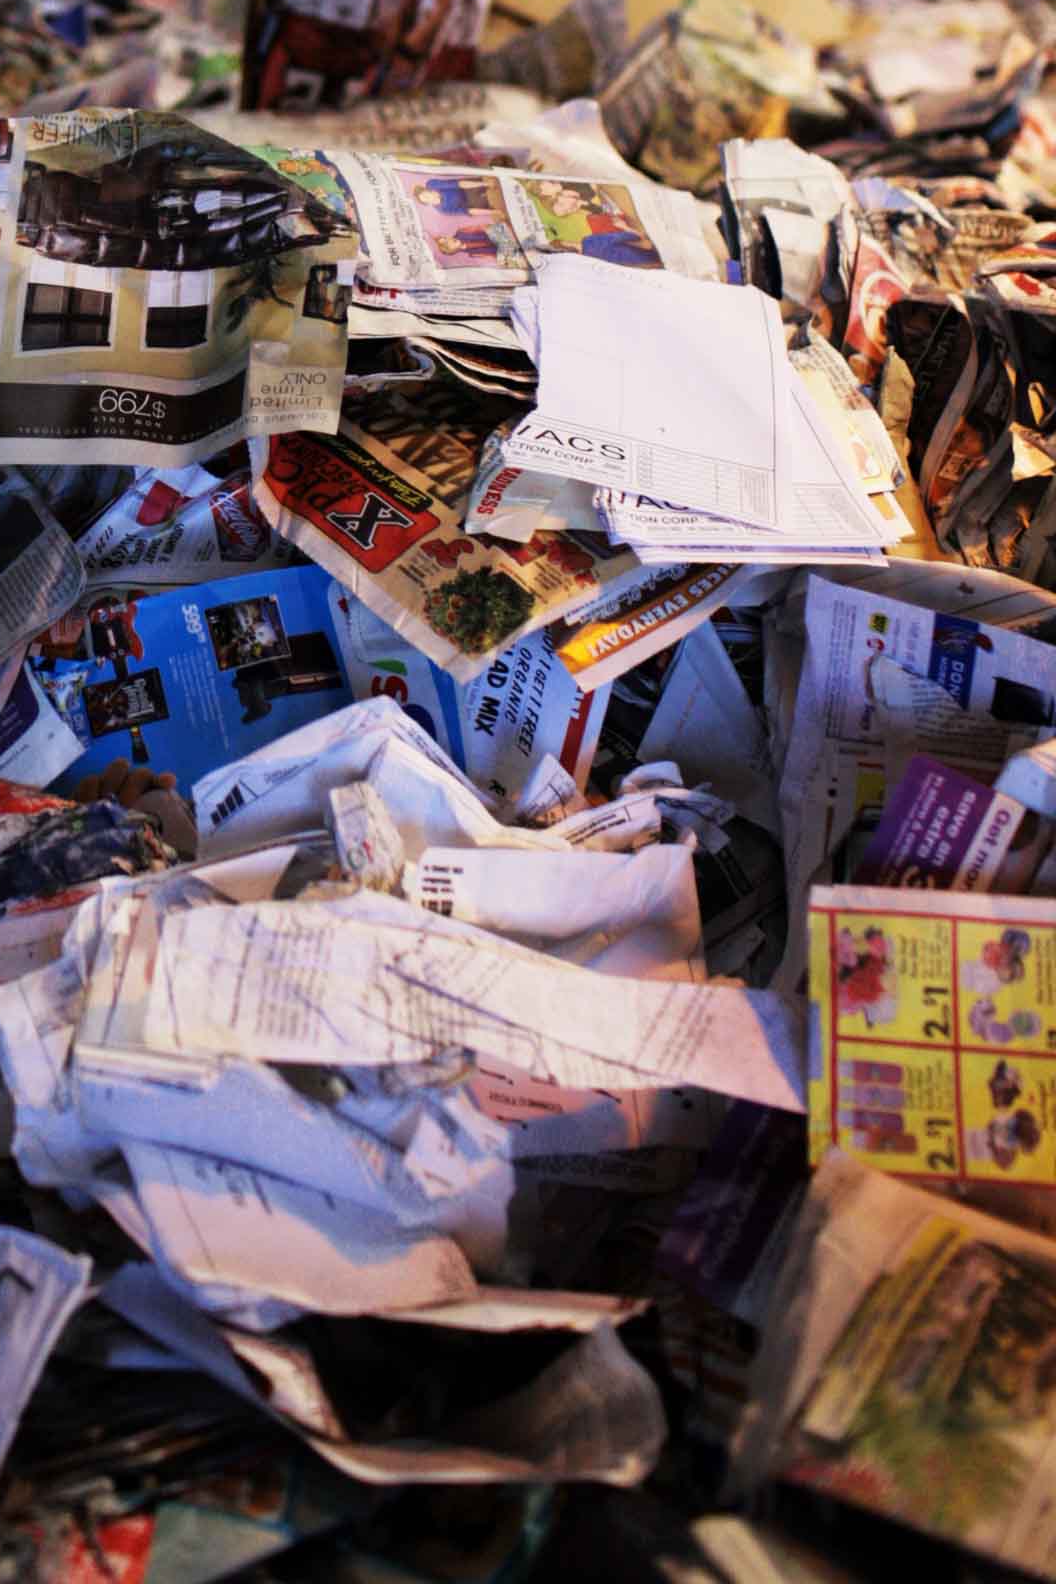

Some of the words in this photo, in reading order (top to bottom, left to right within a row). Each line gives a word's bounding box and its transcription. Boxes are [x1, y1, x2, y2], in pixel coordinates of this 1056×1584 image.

[278, 370, 326, 386] ONLY
[260, 382, 304, 396] Time
[249, 391, 322, 412] Limited
[92, 415, 124, 423] ONLY
[133, 418, 160, 427] NOW
[585, 590, 691, 656] EVERYDAY!
[500, 646, 535, 724] ORGANIC
[530, 670, 548, 697] GET
[472, 694, 503, 737] MIX
[513, 704, 542, 757] FREE!
[921, 1018, 951, 1038] 2
[925, 1150, 956, 1171] 2
